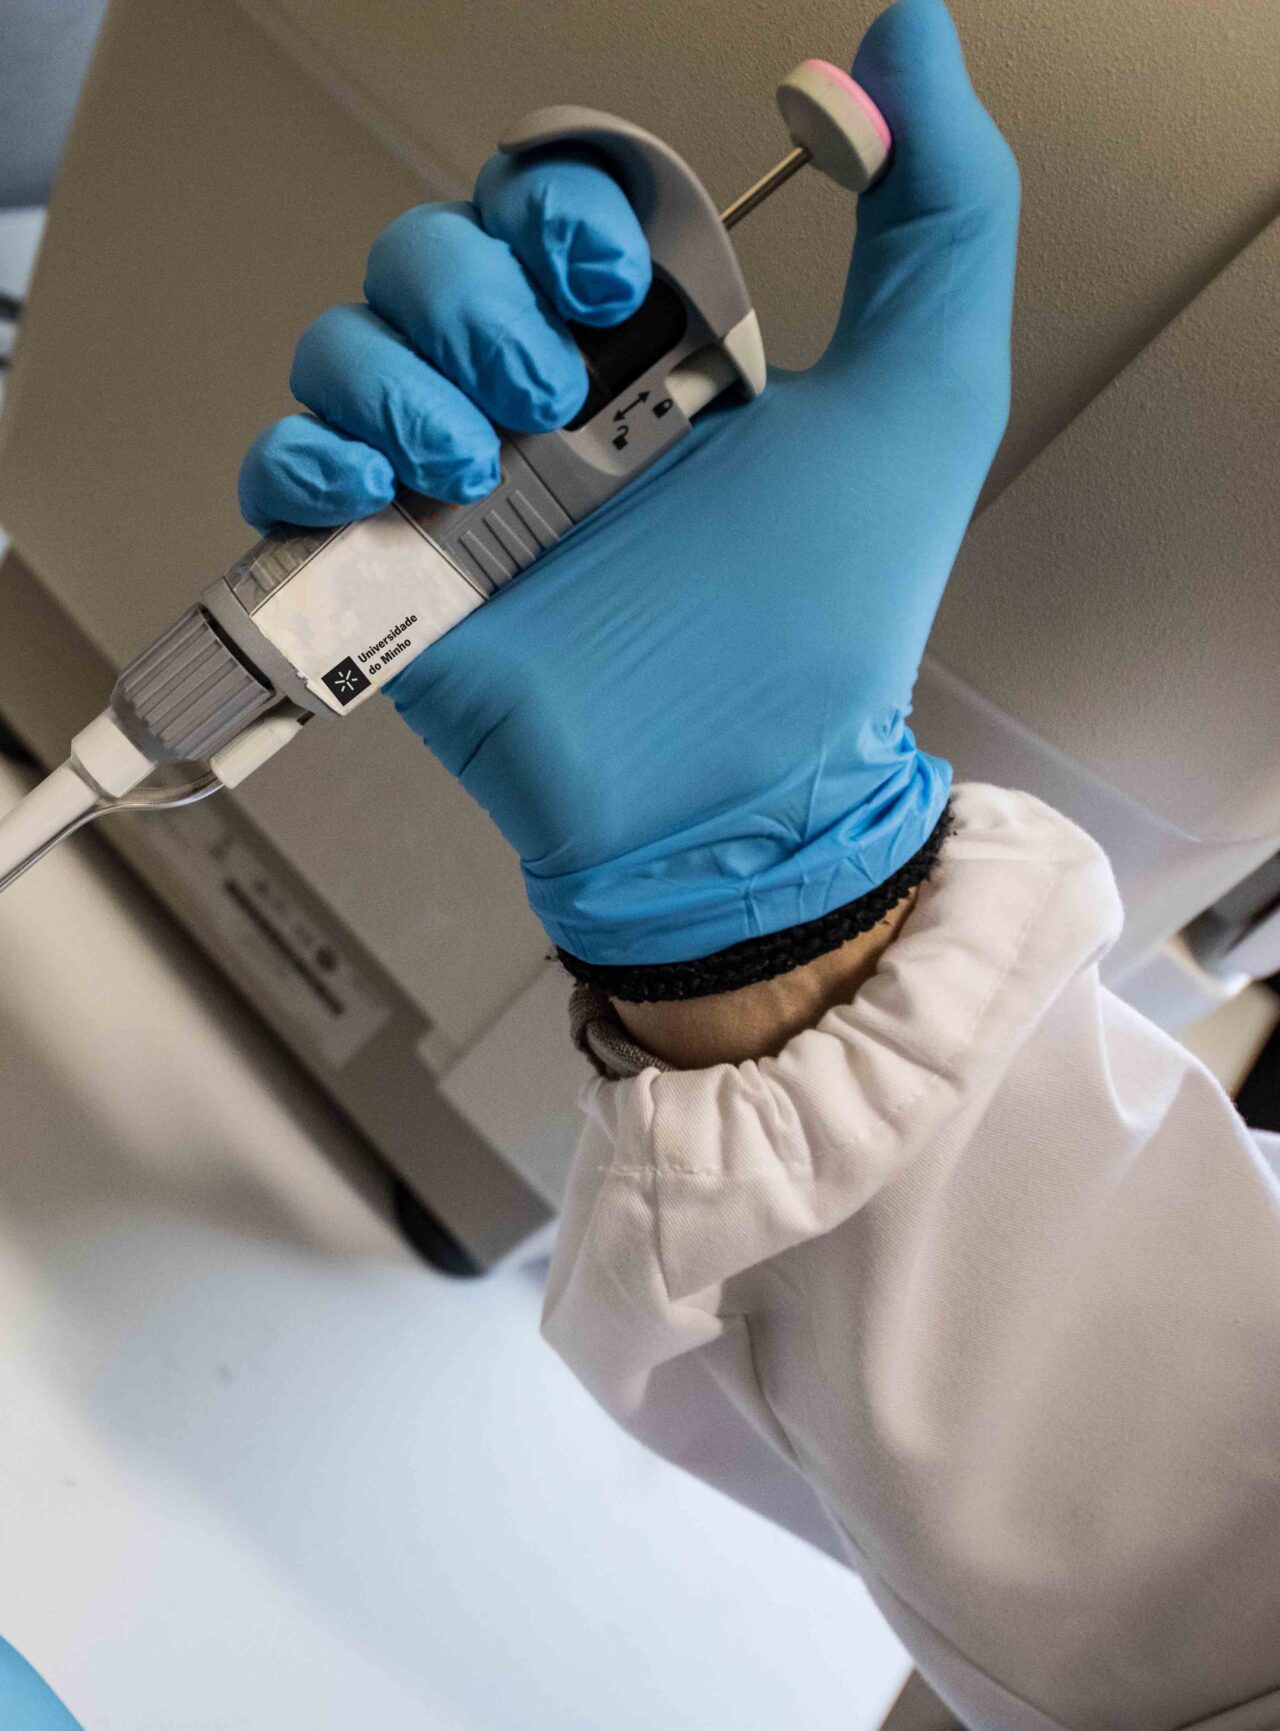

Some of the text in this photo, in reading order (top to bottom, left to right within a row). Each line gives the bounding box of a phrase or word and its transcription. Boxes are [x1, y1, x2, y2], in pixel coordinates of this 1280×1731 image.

[357, 614, 418, 664] Universidade
[368, 638, 412, 676] do Minho
